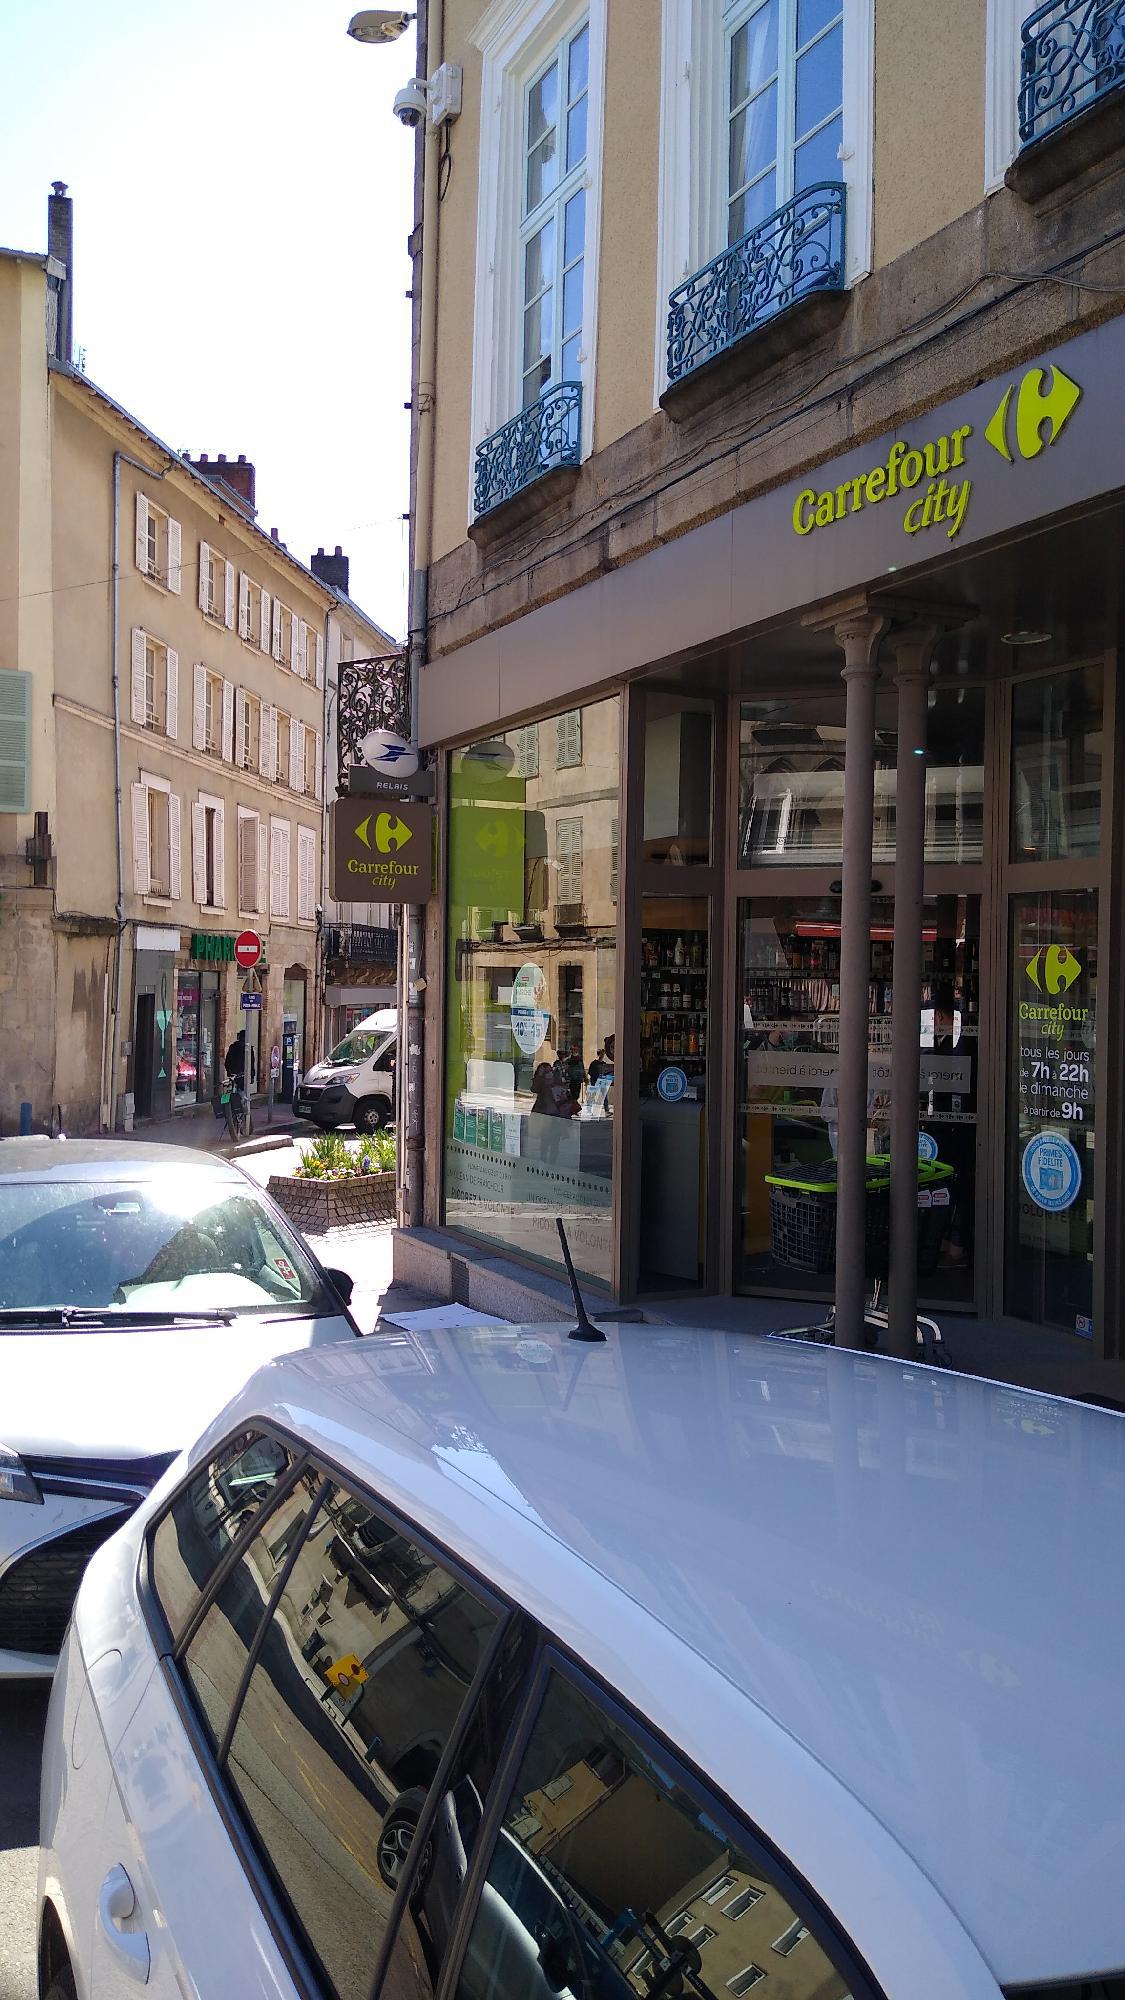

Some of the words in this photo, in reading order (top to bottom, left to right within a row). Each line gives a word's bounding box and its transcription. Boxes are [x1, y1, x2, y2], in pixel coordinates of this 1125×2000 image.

[791, 425, 973, 536] Carrefour
[903, 479, 972, 539] city
[376, 782, 409, 791] RELAIS
[347, 859, 420, 876] Carrefour
[372, 875, 396, 890] city
[1019, 1002, 1089, 1021] Carrefour
[1041, 1021, 1065, 1041] city
[1020, 1045, 1042, 1058] tous
[1045, 1046, 1060, 1060] les
[1062, 1048, 1090, 1062] jours
[1019, 1067, 1029, 1078] de
[1030, 1061, 1050, 1079] 7h
[1052, 1070, 1057, 1080] à
[1059, 1063, 1089, 1083] 22h
[1019, 1082, 1028, 1094] le
[1030, 1081, 1089, 1100] dimanche
[1023, 1105, 1029, 1114] à
[1029, 1106, 1050, 1117] partir
[1050, 1108, 1061, 1118] de
[1061, 1102, 1083, 1121] 9h
[1039, 1147, 1063, 1158] PRIMES
